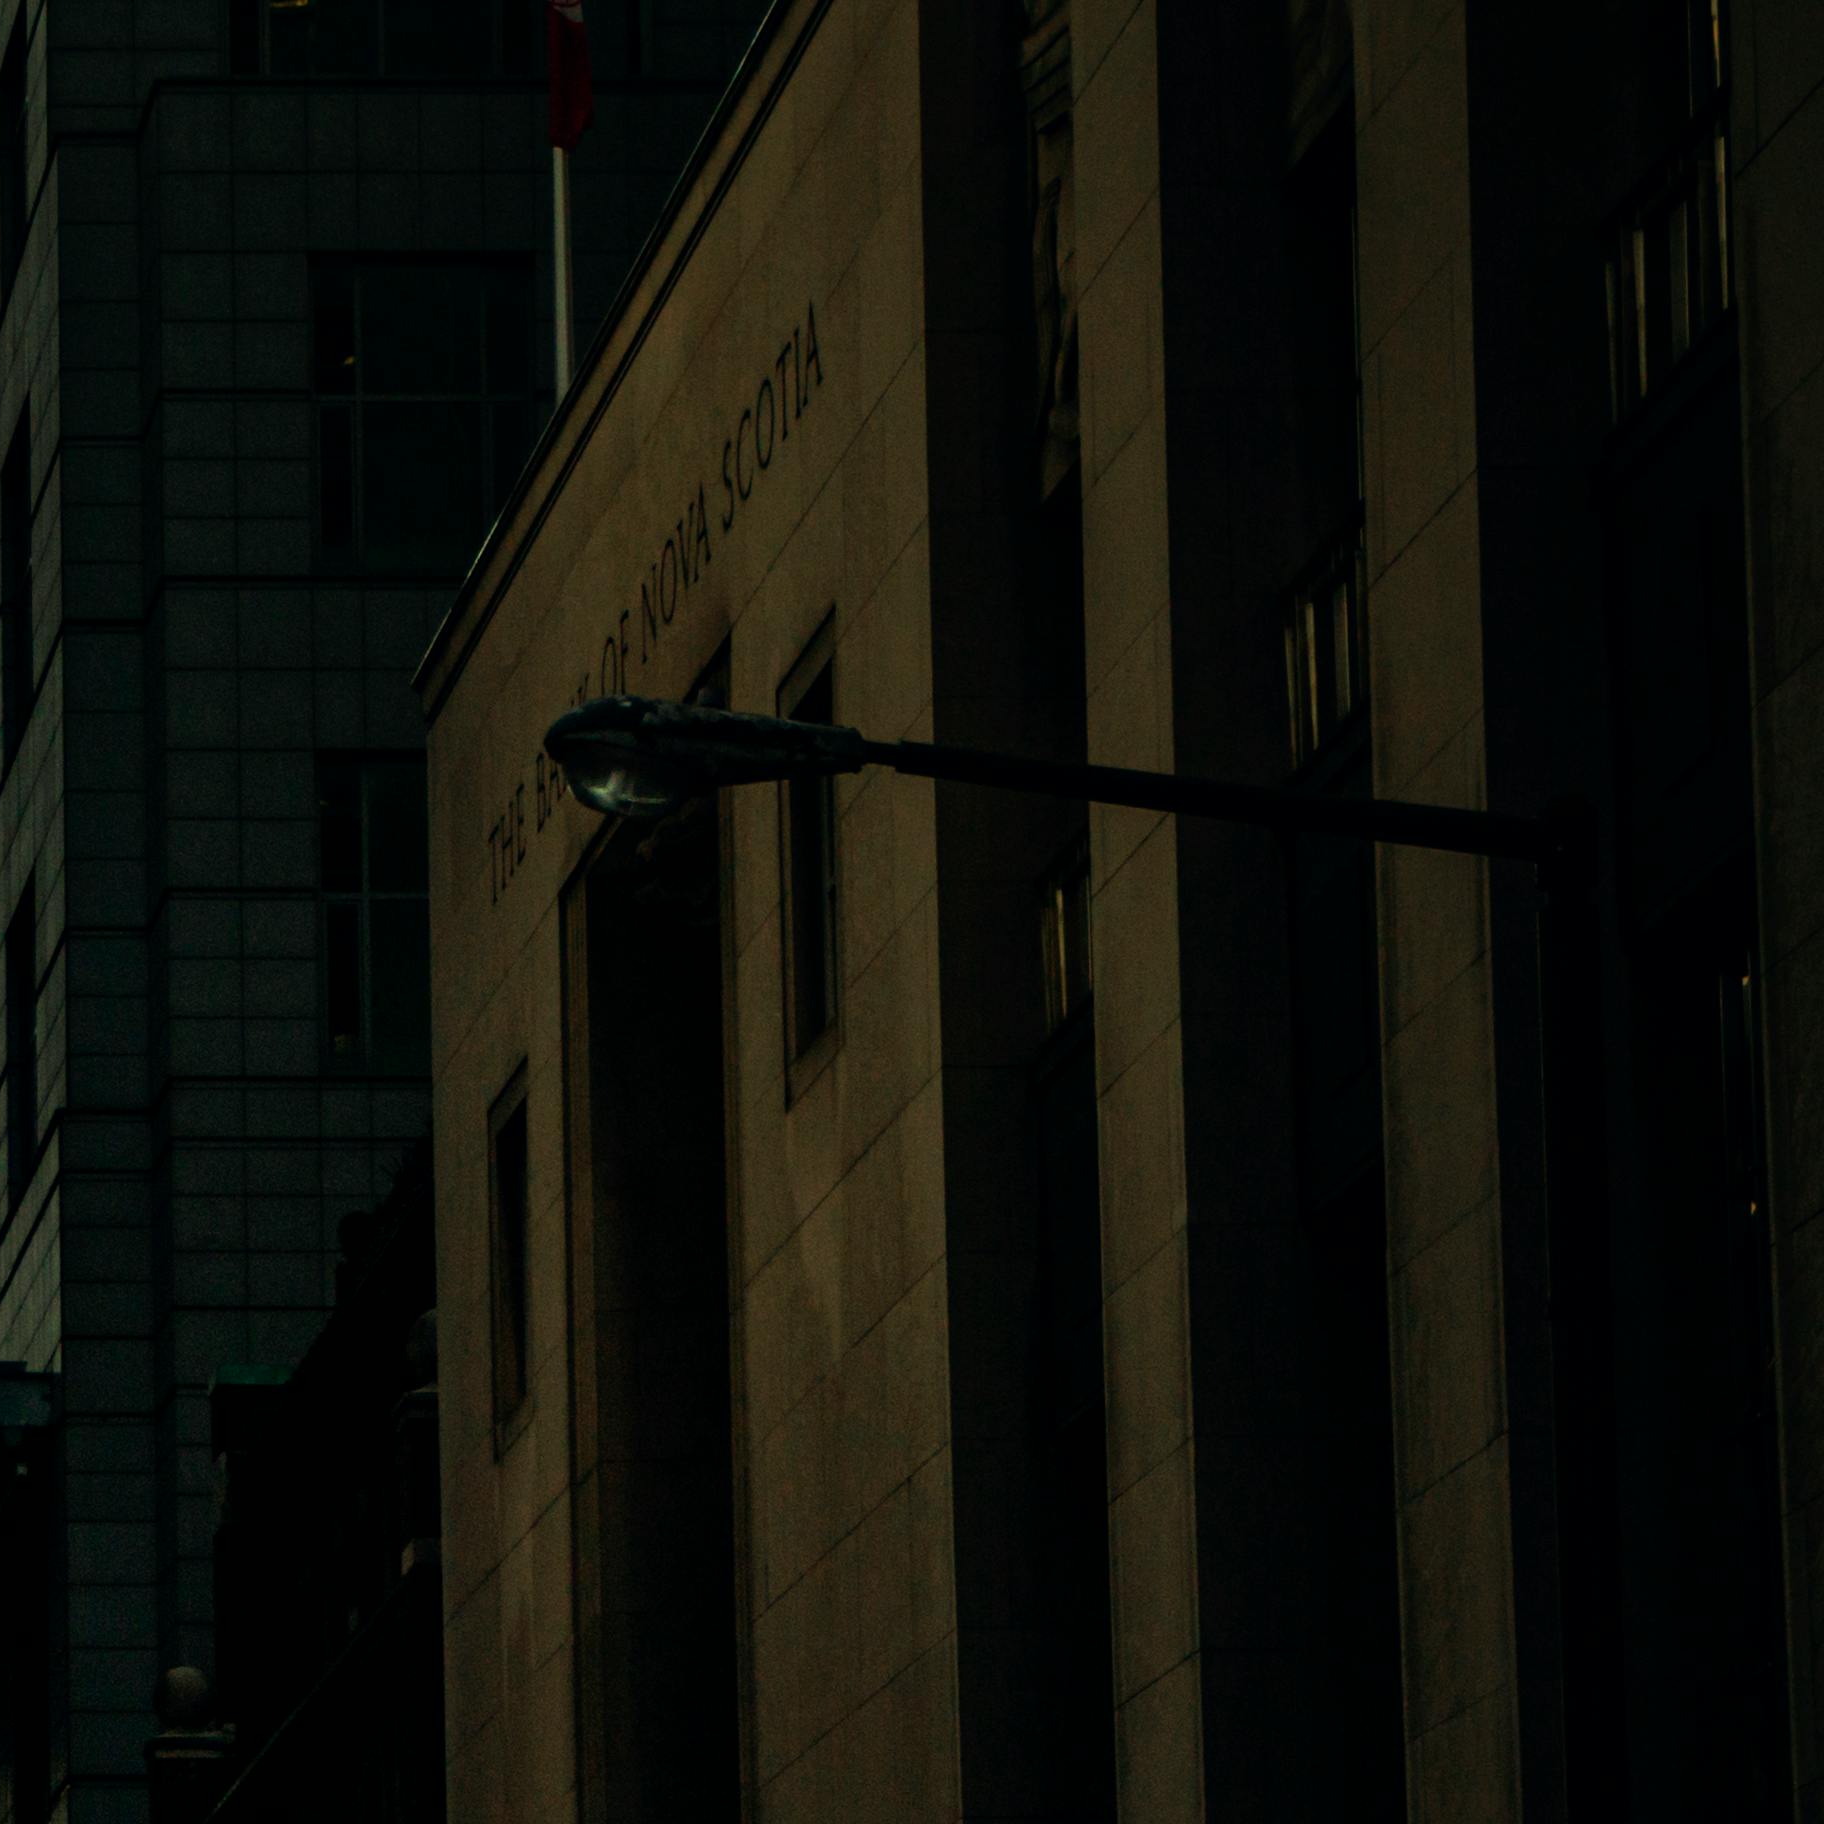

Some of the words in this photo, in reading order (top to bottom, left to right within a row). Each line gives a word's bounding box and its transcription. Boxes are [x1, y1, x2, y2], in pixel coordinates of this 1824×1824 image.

[489, 782, 525, 904] THE
[642, 482, 711, 665] NOVA
[723, 299, 823, 533] SCOTIA
